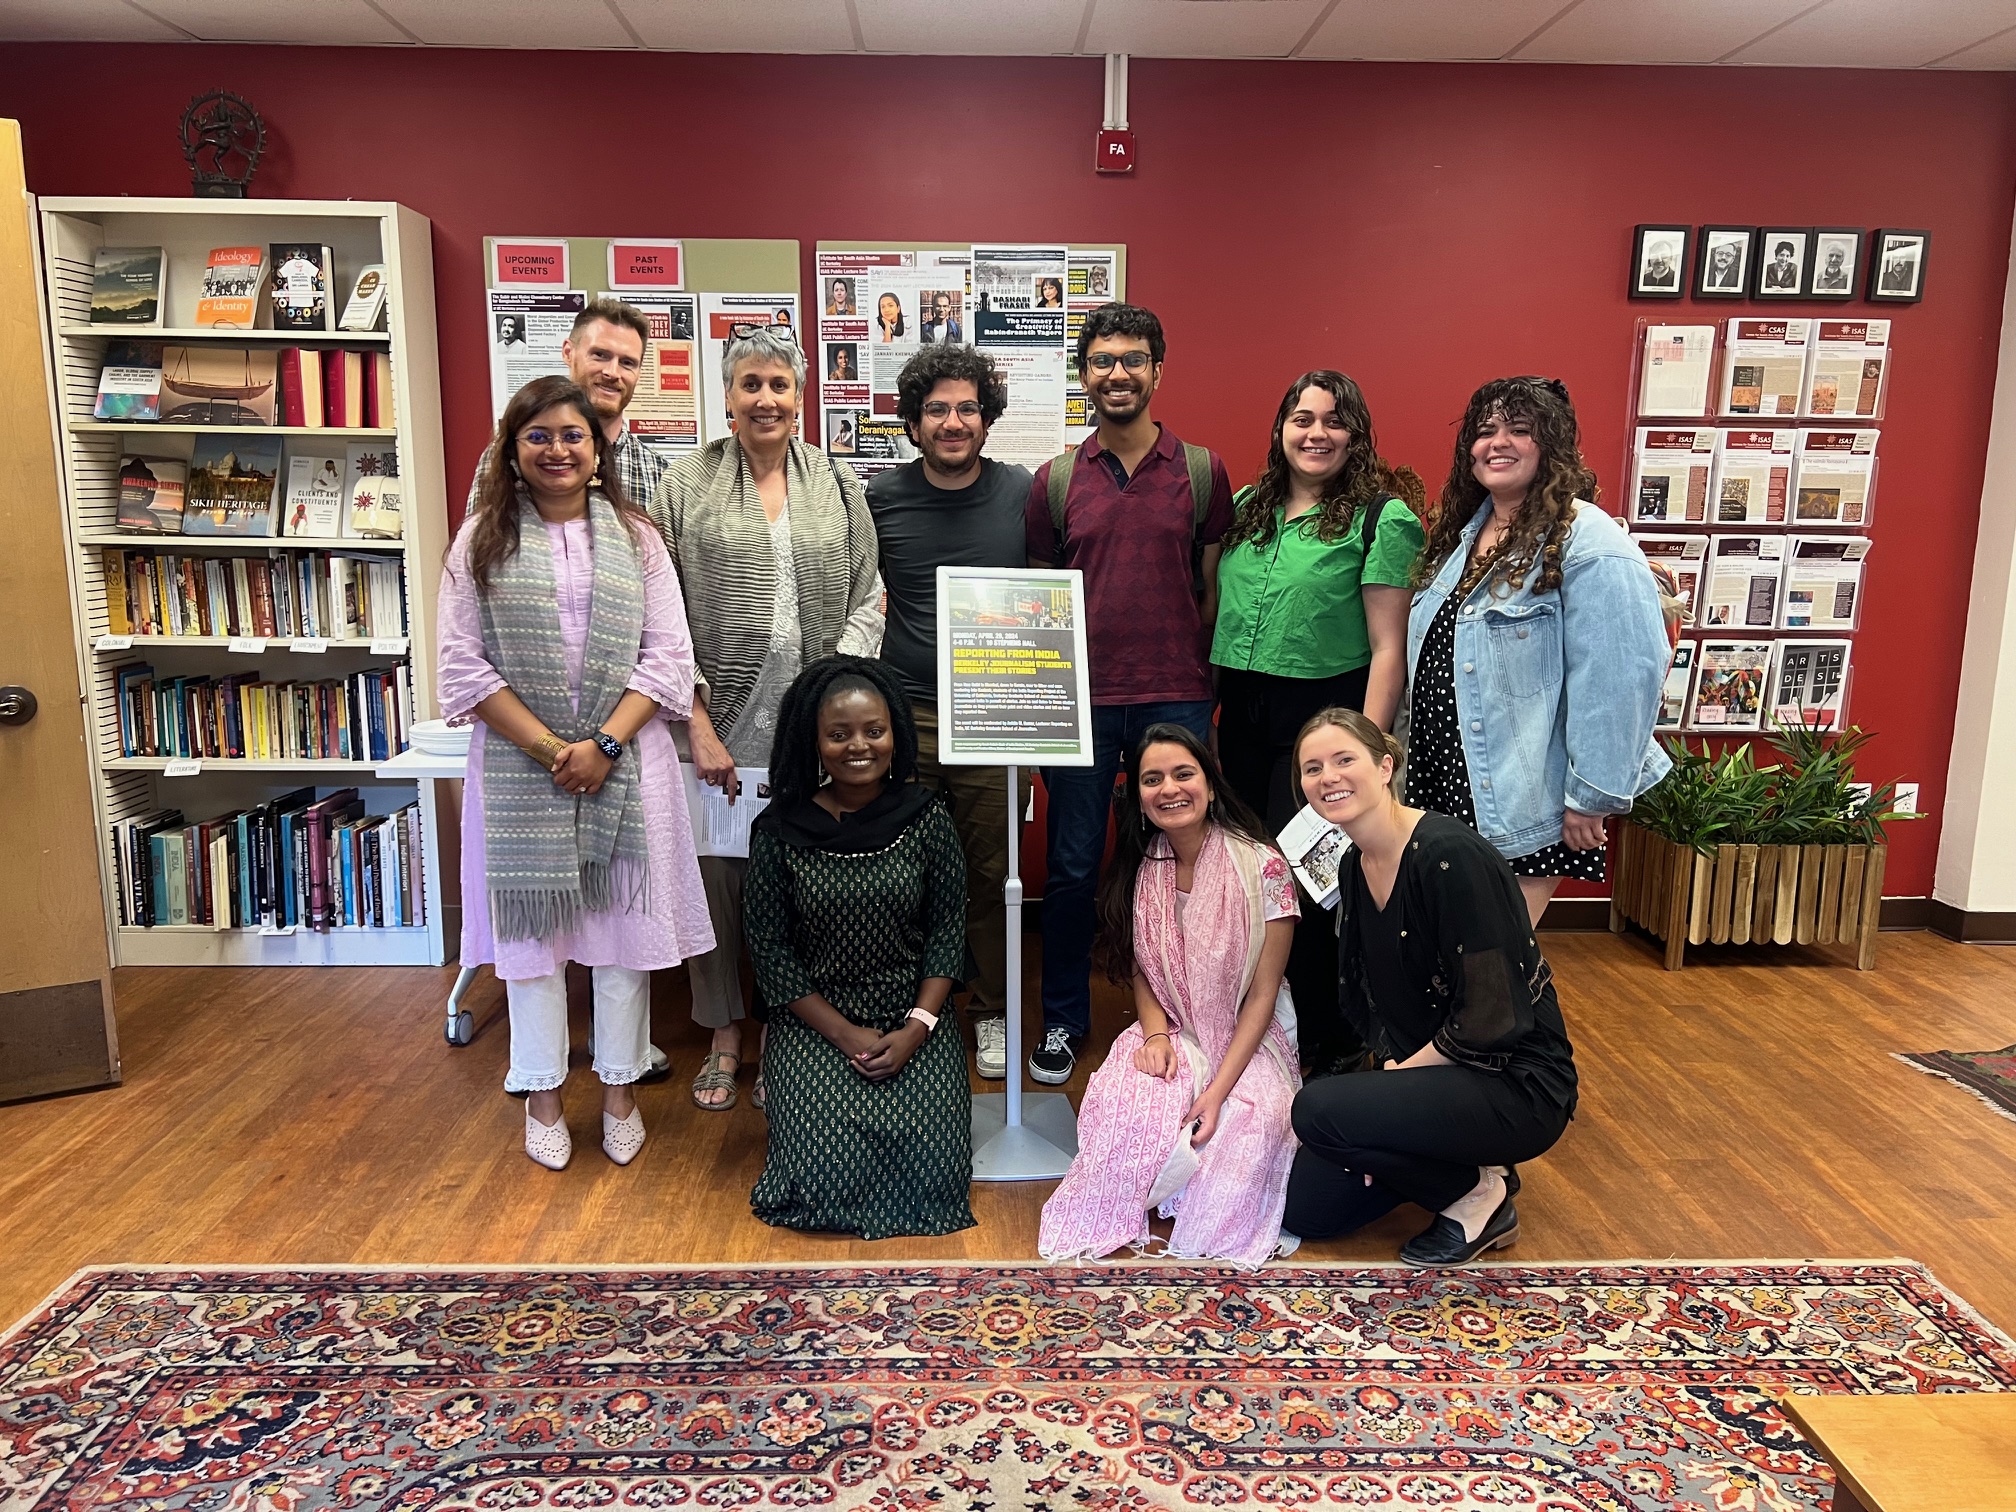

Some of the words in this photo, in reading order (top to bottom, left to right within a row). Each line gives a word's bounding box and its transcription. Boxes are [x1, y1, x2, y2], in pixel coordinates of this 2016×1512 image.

[1110, 143, 1125, 155] FA
[214, 250, 252, 263] Ideology
[505, 256, 555, 265] UPCOMING
[635, 256, 658, 264] PAST
[512, 267, 548, 275] EVENTS
[630, 266, 664, 274] EVENTS
[213, 301, 249, 313] Identity
[649, 329, 669, 337] CHKE
[858, 426, 907, 436] Deraniyagal
[298, 490, 324, 498] CLIENTS
[189, 499, 215, 508] SIKH
[217, 499, 268, 510] HERITAGE
[292, 497, 338, 506] CONSTITUENTS
[106, 575, 122, 587] RAJ
[953, 649, 1006, 658] REPORTING
[1007, 650, 1034, 659] FROM
[1034, 650, 1061, 660] INDIA
[953, 666, 985, 674] PRESENT
[171, 850, 179, 871] INDIA
[134, 880, 143, 913] ATLAS
